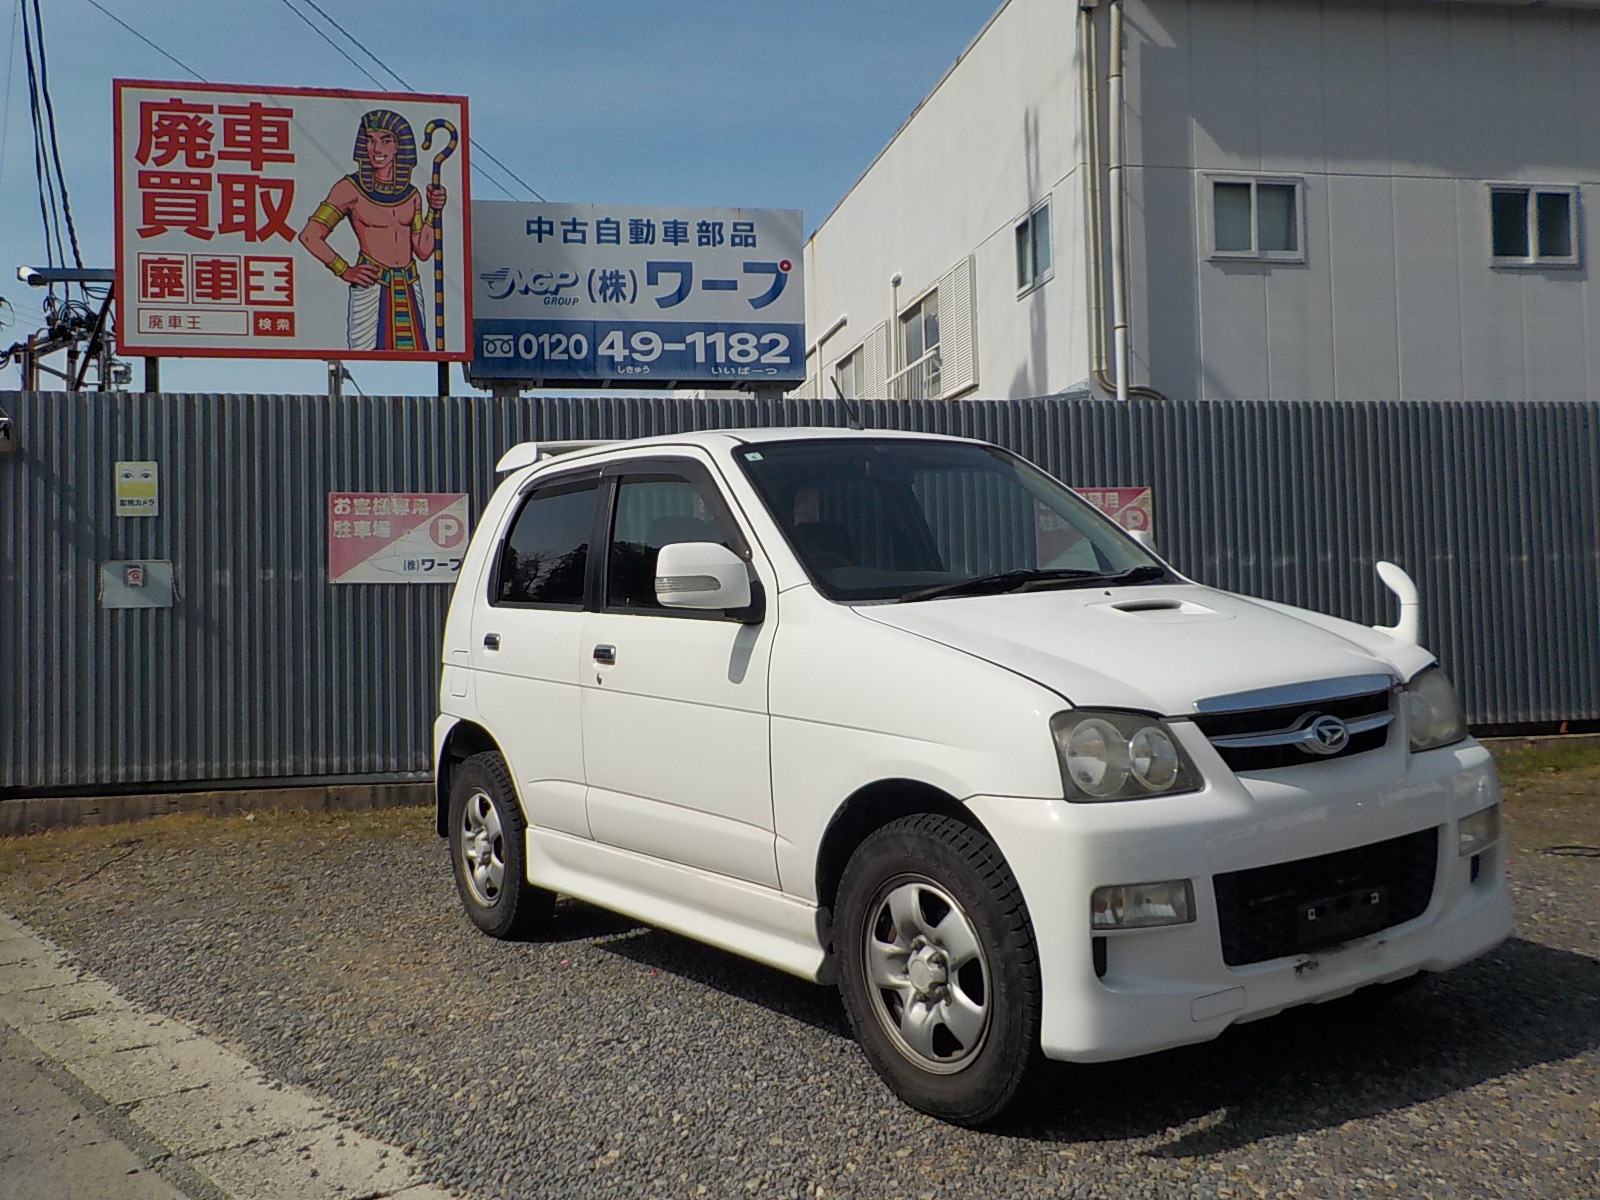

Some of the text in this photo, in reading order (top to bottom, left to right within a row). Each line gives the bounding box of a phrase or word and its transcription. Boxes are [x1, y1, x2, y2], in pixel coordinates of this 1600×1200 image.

[135, 98, 295, 171] 廃車
[136, 170, 297, 242] 買取
[526, 215, 757, 247] 中古自動車部品
[139, 253, 294, 306] 廃車王
[543, 296, 579, 306] GROUP
[148, 315, 202, 330] 廃車王
[258, 317, 290, 331] 検索
[518, 330, 791, 363] 0120 49-1182
[333, 520, 391, 538] 駐車場
[438, 518, 459, 544] P
